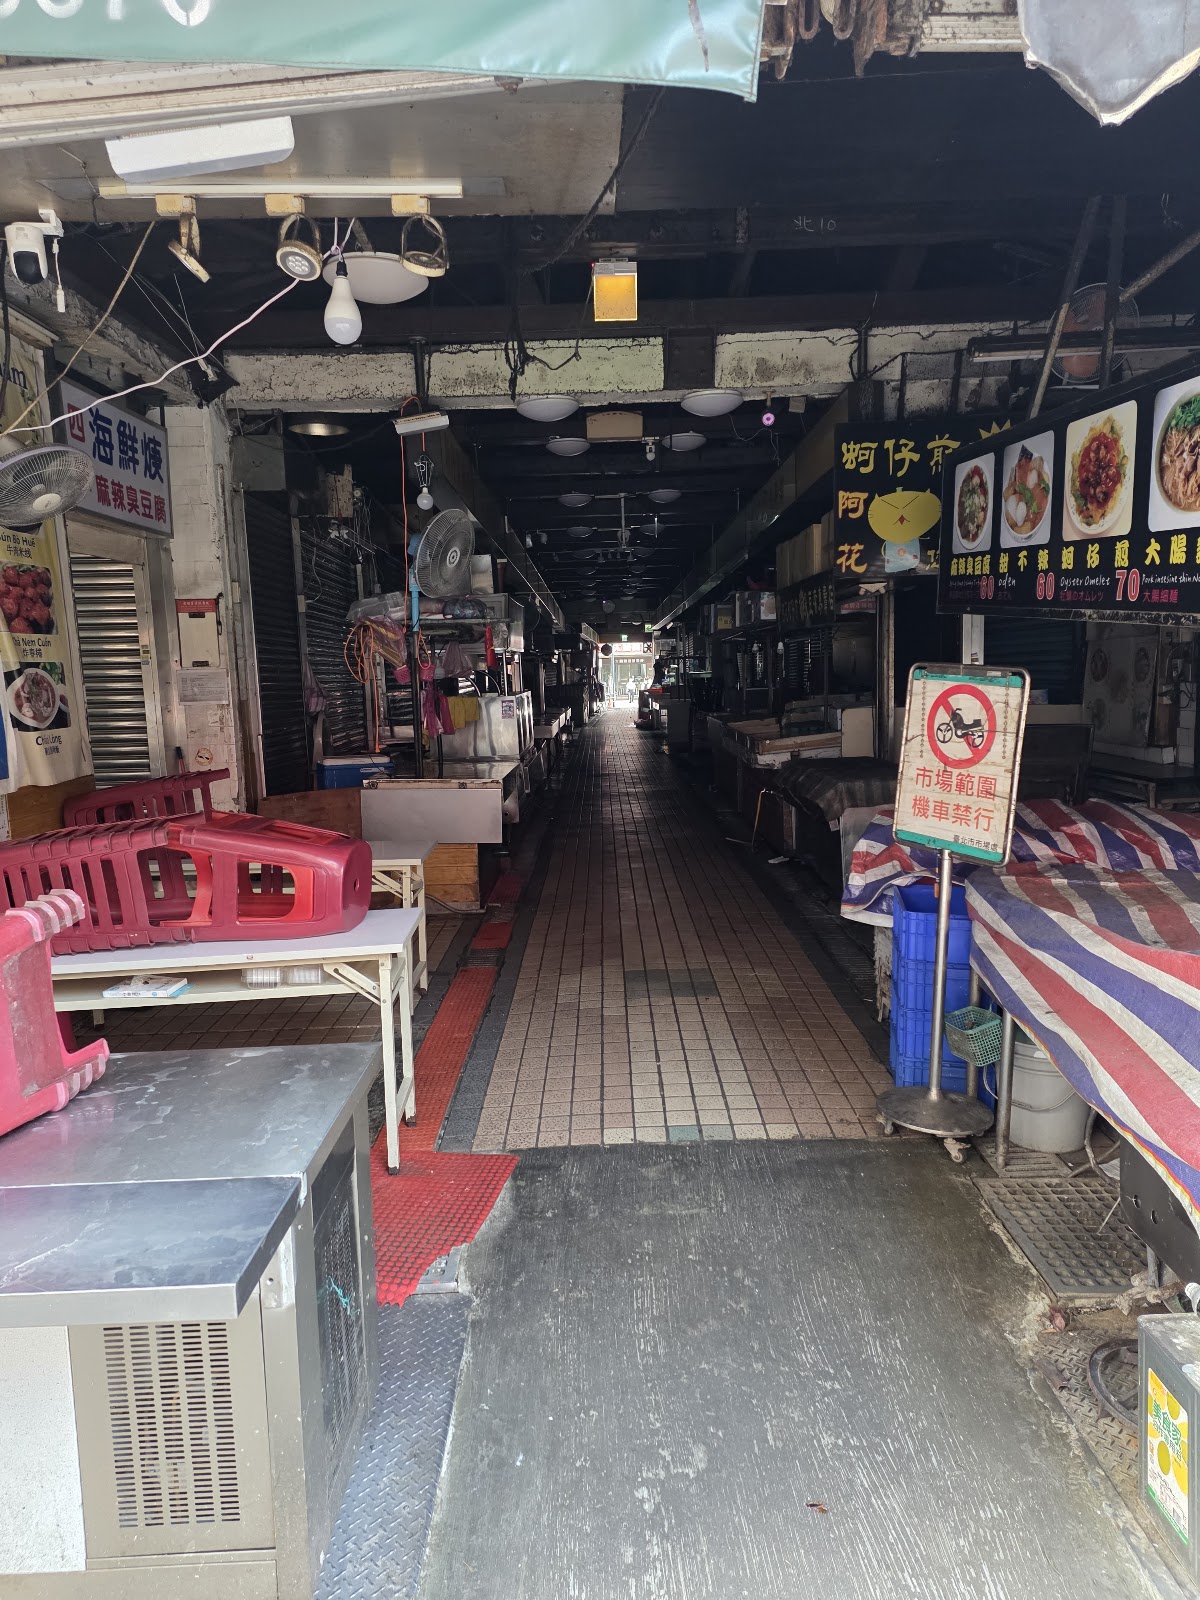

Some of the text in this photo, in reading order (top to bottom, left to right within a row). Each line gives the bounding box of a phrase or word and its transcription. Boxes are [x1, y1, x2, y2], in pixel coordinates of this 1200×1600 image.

[95, 474, 167, 525] 麻辣臭豆腐
[999, 548, 1049, 574] 甜不辣
[1061, 539, 1130, 570] 蚵仔煎
[1144, 533, 1200, 566] 大腸
[980, 575, 995, 600] 60
[1036, 572, 1055, 600] 60
[1115, 568, 1140, 602] 70
[915, 766, 997, 801] 市場範圍
[912, 795, 995, 832] 機車禁行
